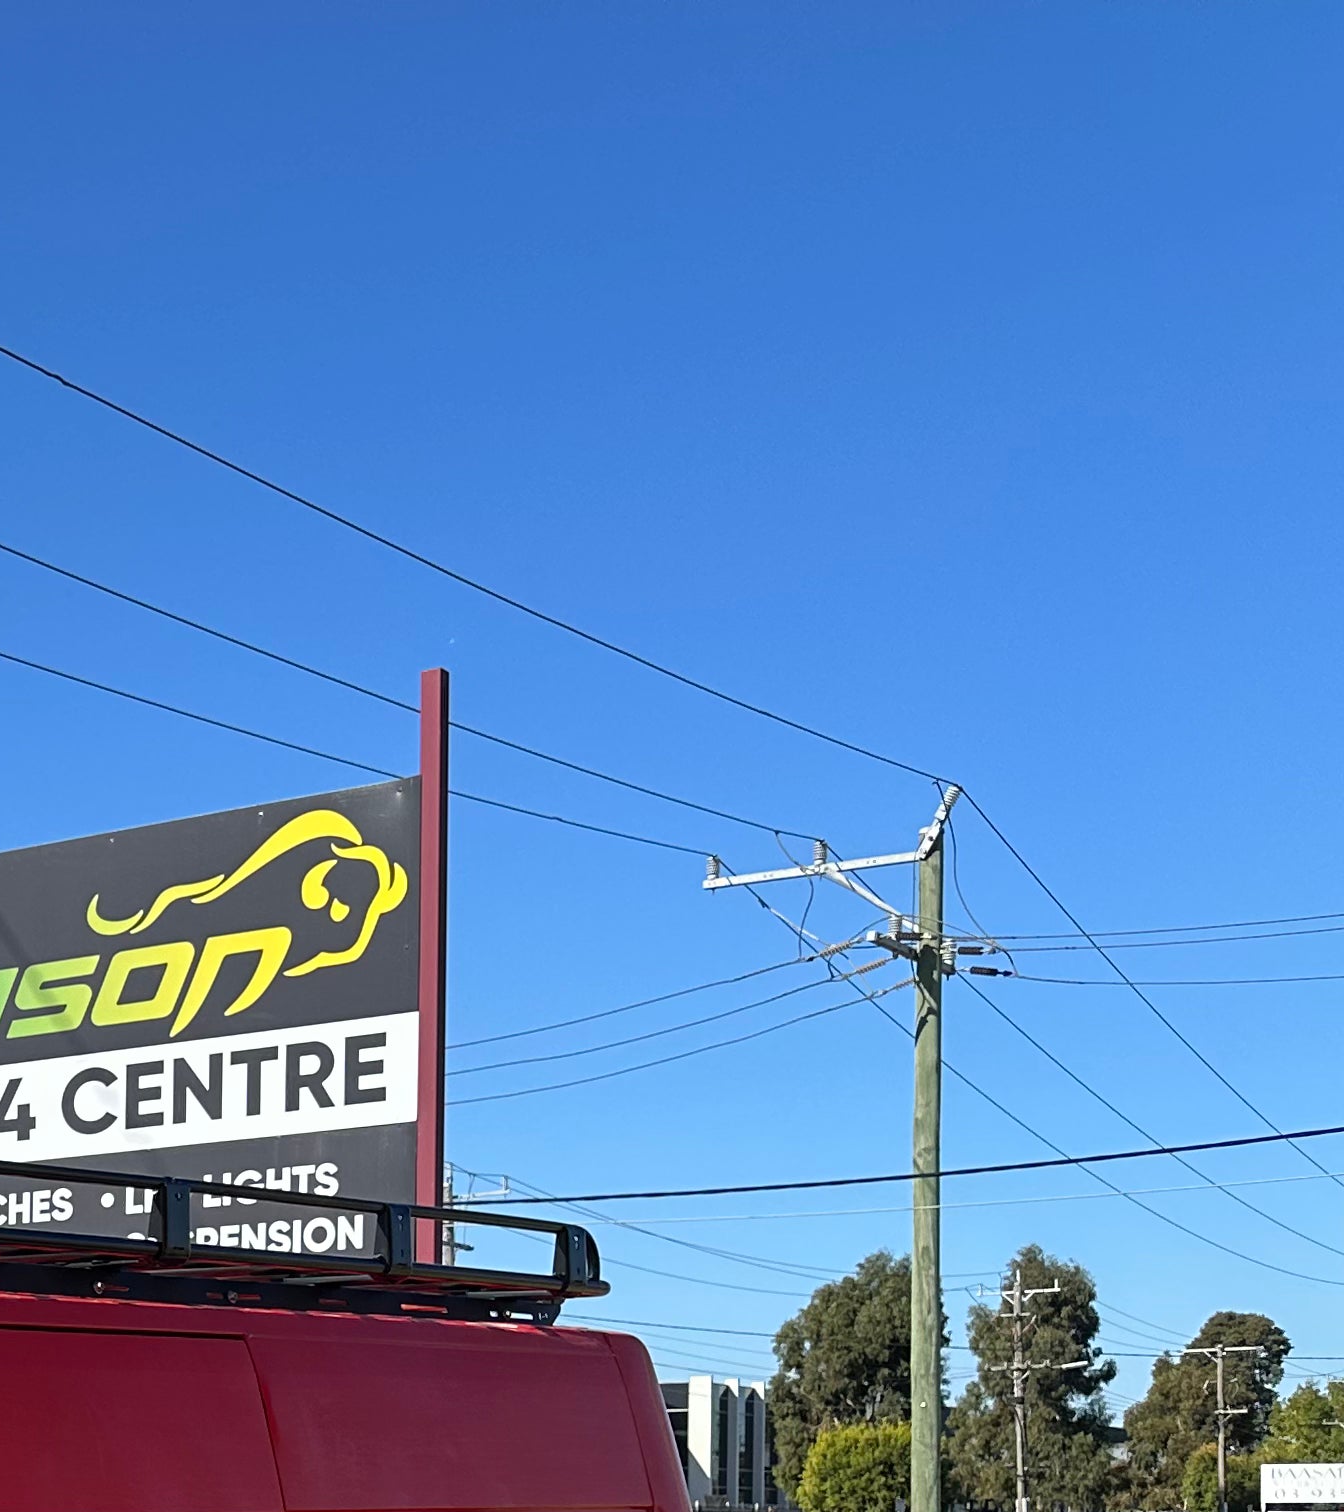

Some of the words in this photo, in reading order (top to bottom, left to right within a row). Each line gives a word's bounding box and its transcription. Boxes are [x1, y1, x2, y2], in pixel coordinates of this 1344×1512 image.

[61, 1032, 388, 1135] CENTRE
[202, 1162, 339, 1208] LIGHTS
[127, 1214, 363, 1254] PENSION
